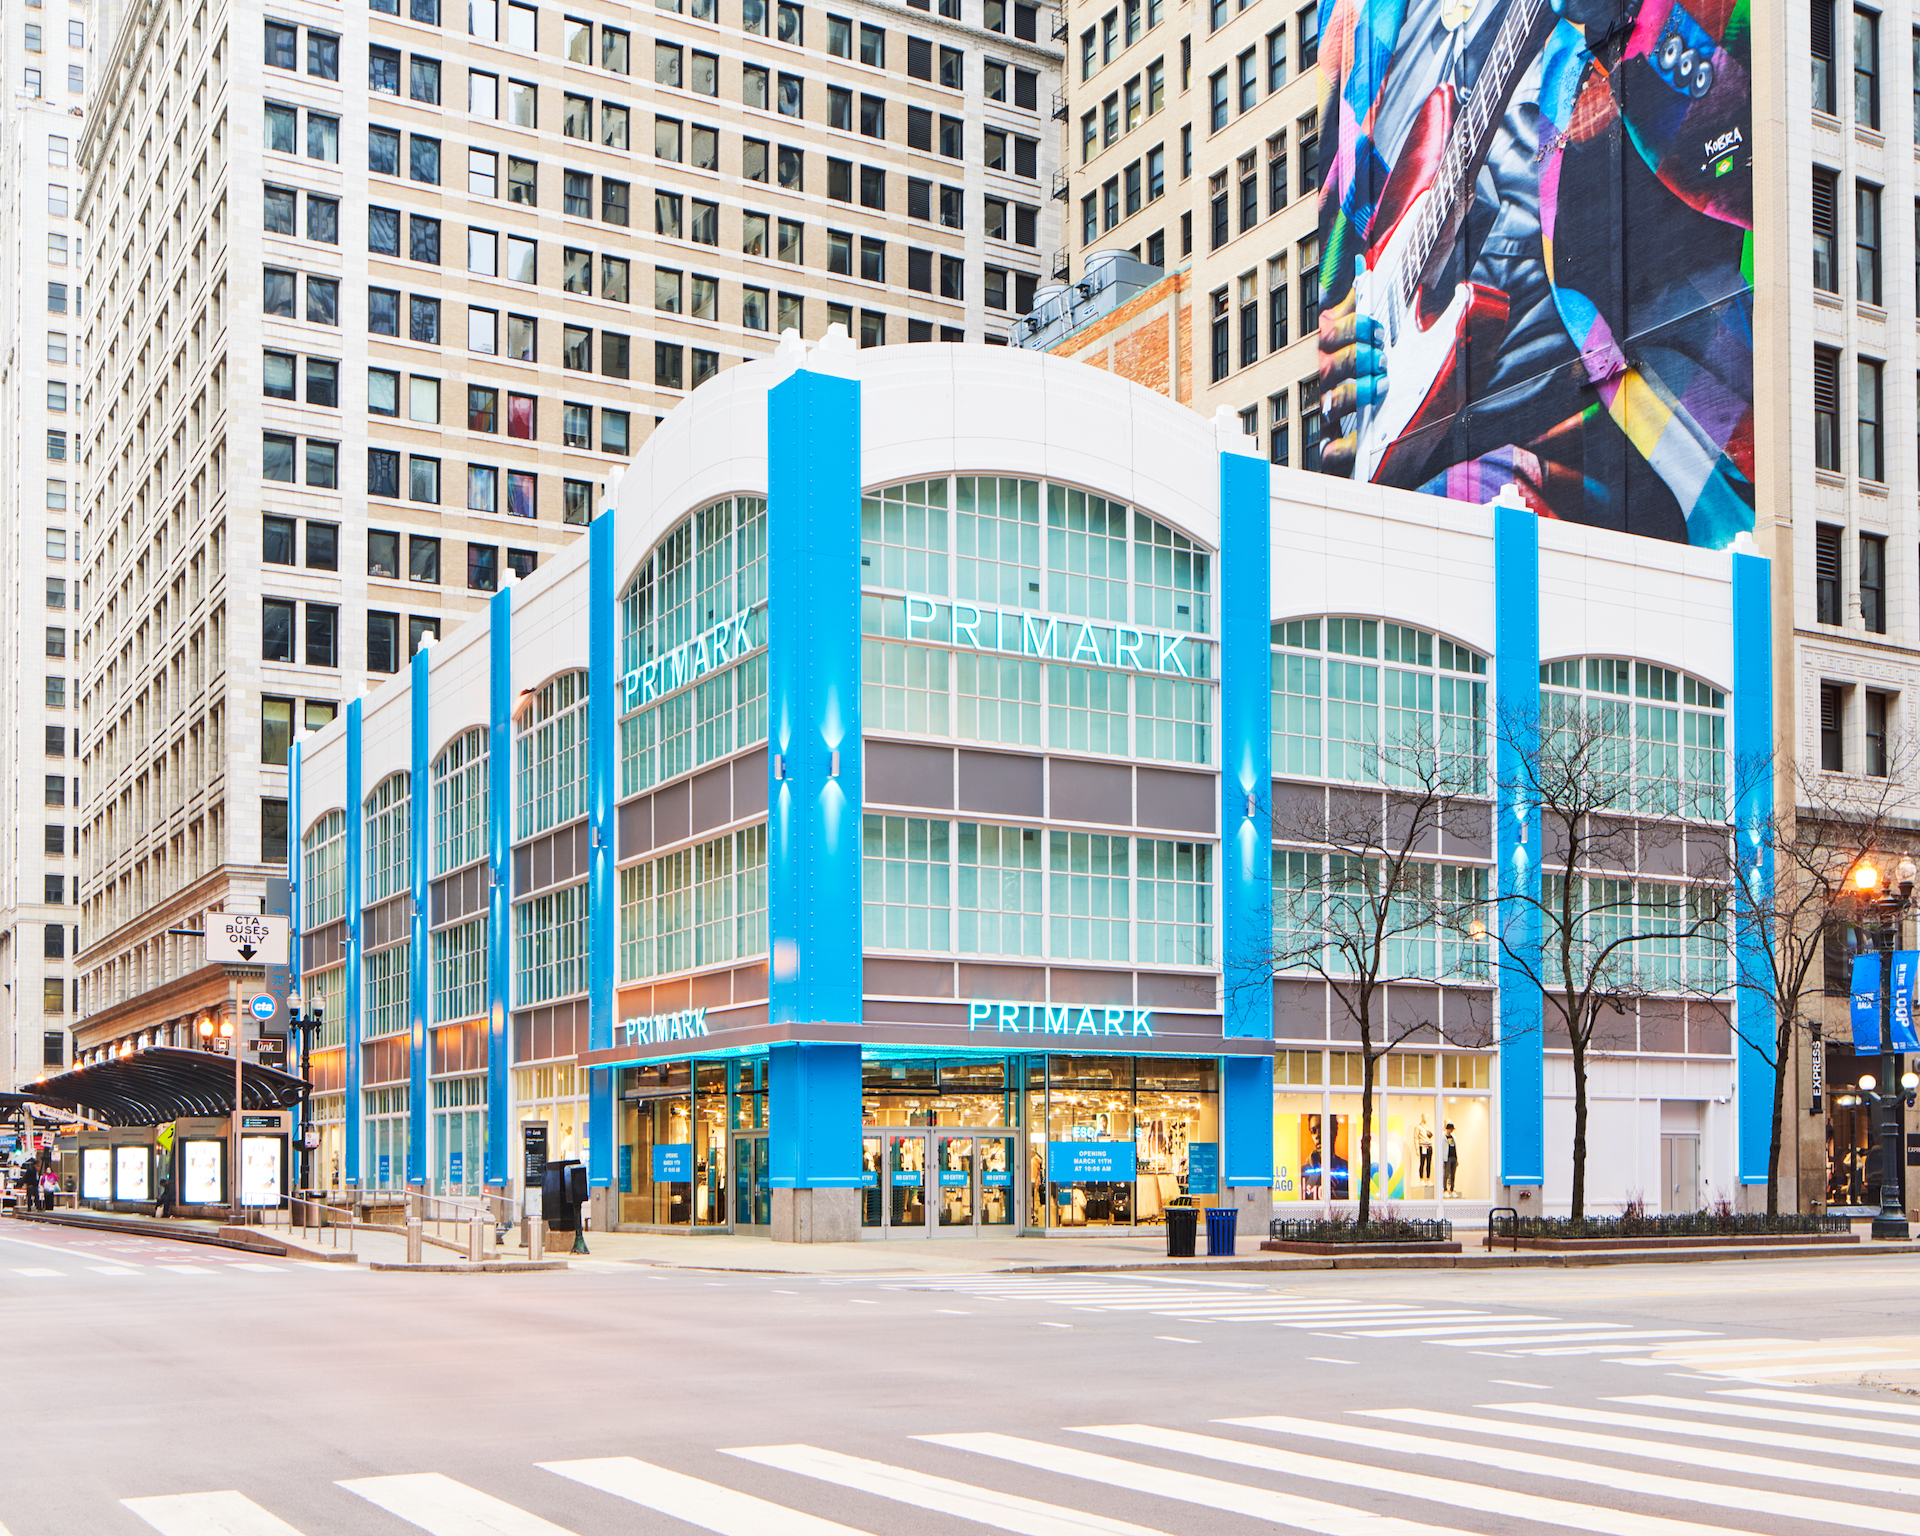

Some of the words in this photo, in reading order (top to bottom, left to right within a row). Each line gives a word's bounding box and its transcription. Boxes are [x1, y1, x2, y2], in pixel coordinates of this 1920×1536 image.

[1704, 126, 1743, 157] KOBRA
[904, 595, 1188, 678] PRIMARK
[625, 606, 754, 714] PRIMARK
[226, 925, 269, 935] BUSES
[235, 916, 260, 925] CTA
[229, 935, 265, 944] ONLY
[1897, 972, 1906, 986] THE
[1898, 963, 1908, 972] IN
[969, 1000, 1153, 1037] PRIMARK
[1895, 989, 1910, 1027] LOOP
[626, 1006, 709, 1047] PRIMARK
[1812, 1040, 1821, 1096] EXPRESS
